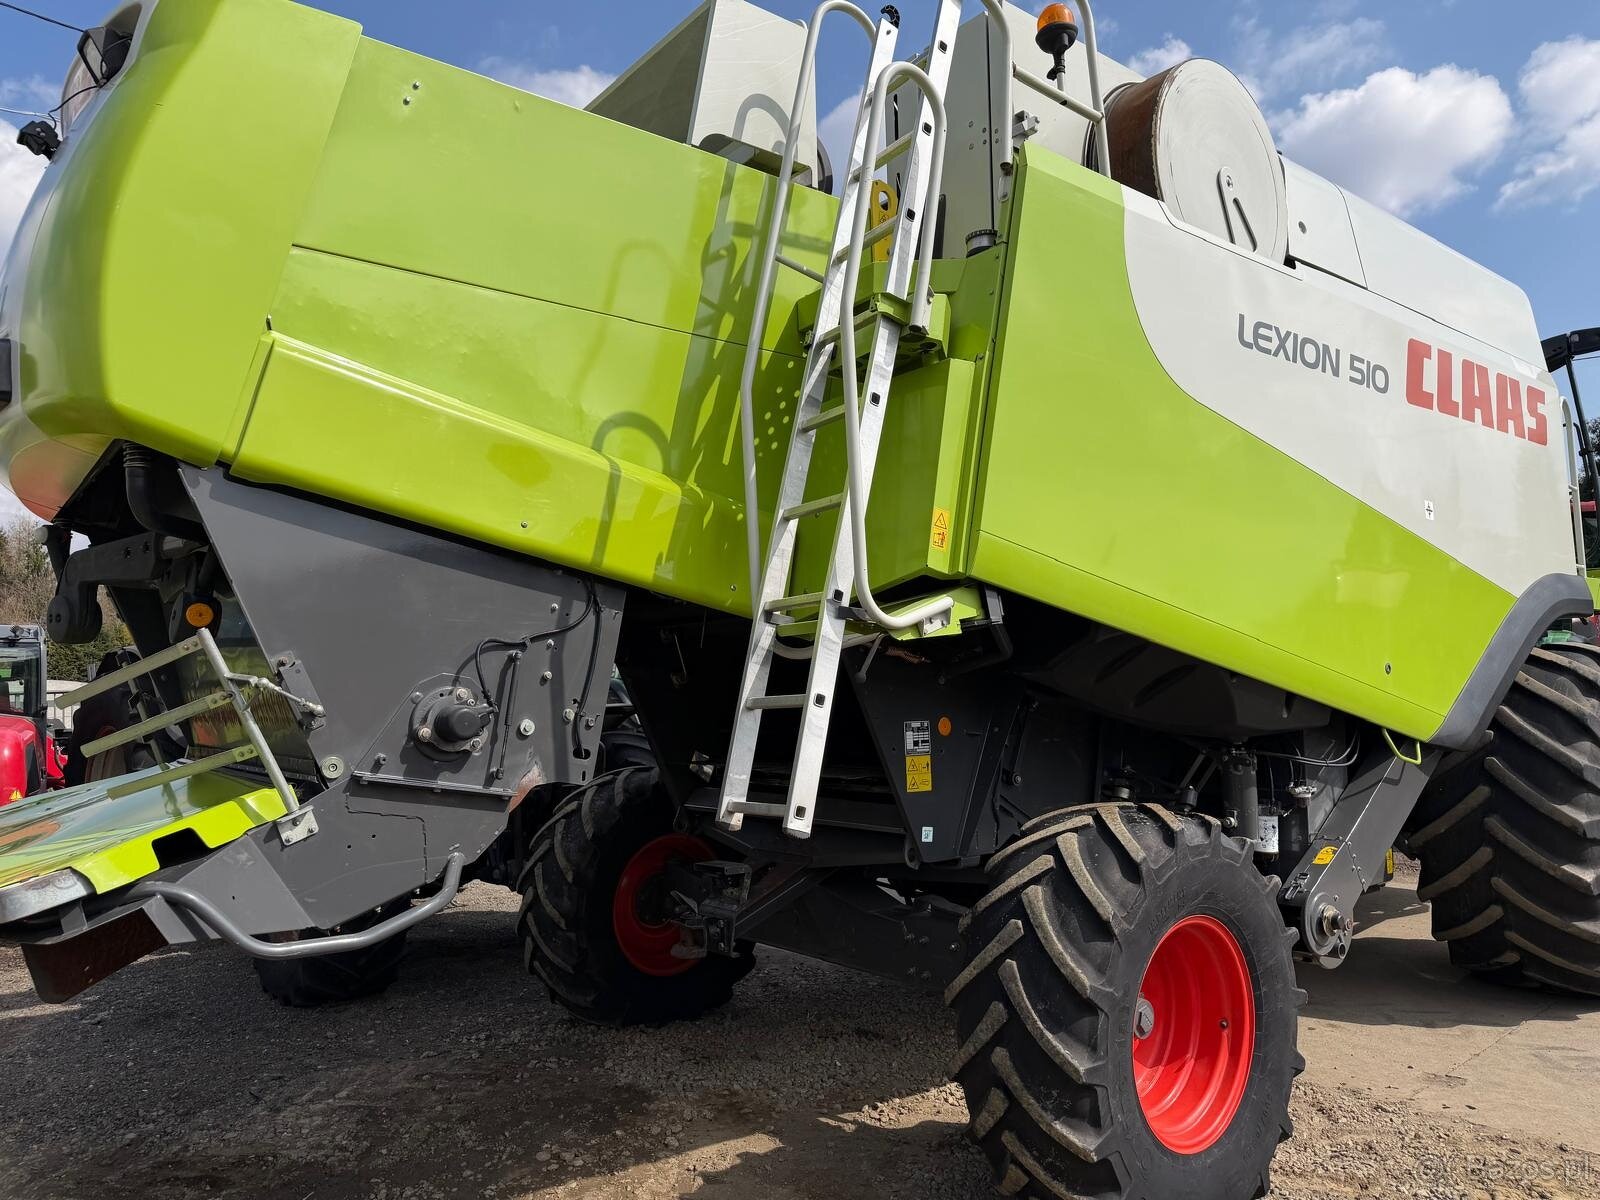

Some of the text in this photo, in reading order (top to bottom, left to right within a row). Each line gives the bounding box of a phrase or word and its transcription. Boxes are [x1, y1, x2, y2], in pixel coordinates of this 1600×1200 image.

[1237, 313, 1390, 395] LEXION 510
[1405, 338, 1548, 446] CLAAS
